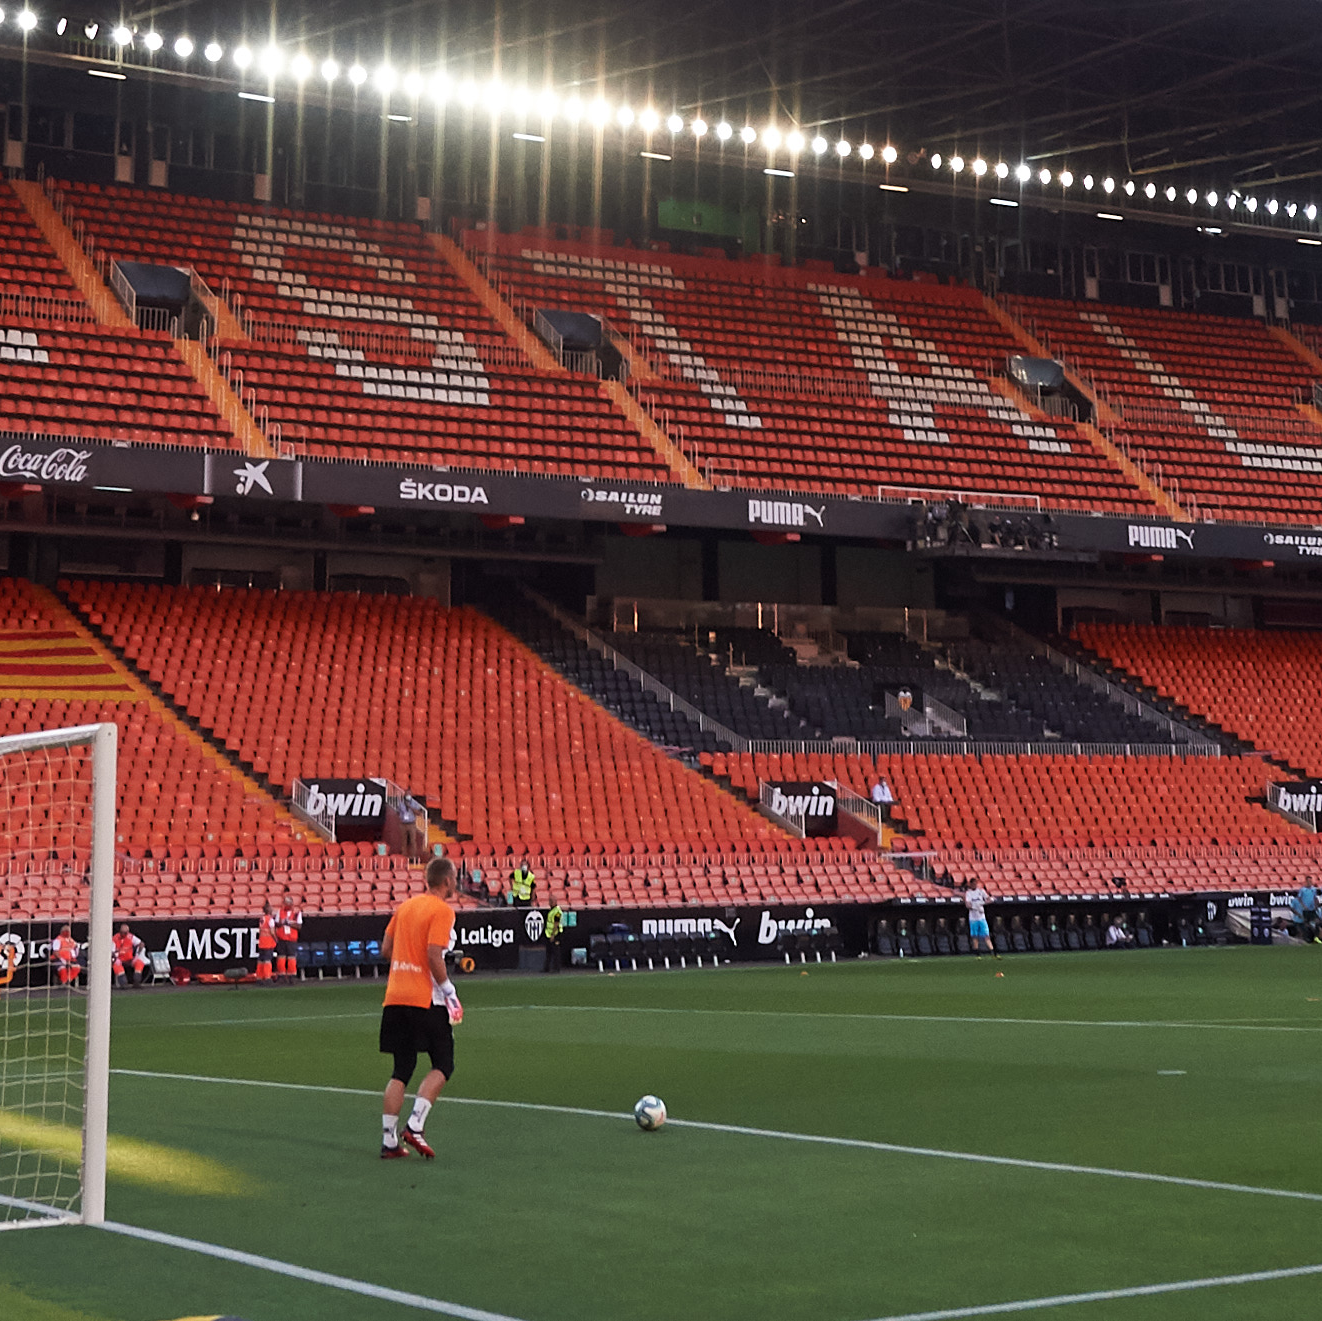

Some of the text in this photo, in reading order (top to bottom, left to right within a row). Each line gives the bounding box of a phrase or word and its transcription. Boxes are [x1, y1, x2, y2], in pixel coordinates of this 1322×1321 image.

[399, 478, 490, 504] ŠKODA
[595, 490, 662, 506] SAILUN
[624, 503, 663, 517] TYRE
[748, 499, 806, 528] PUMA
[1128, 524, 1178, 549] PUMA
[306, 782, 383, 817] bwin
[771, 785, 835, 816] bwin
[164, 927, 260, 961] AMSTE
[460, 924, 514, 948] LaLiga
